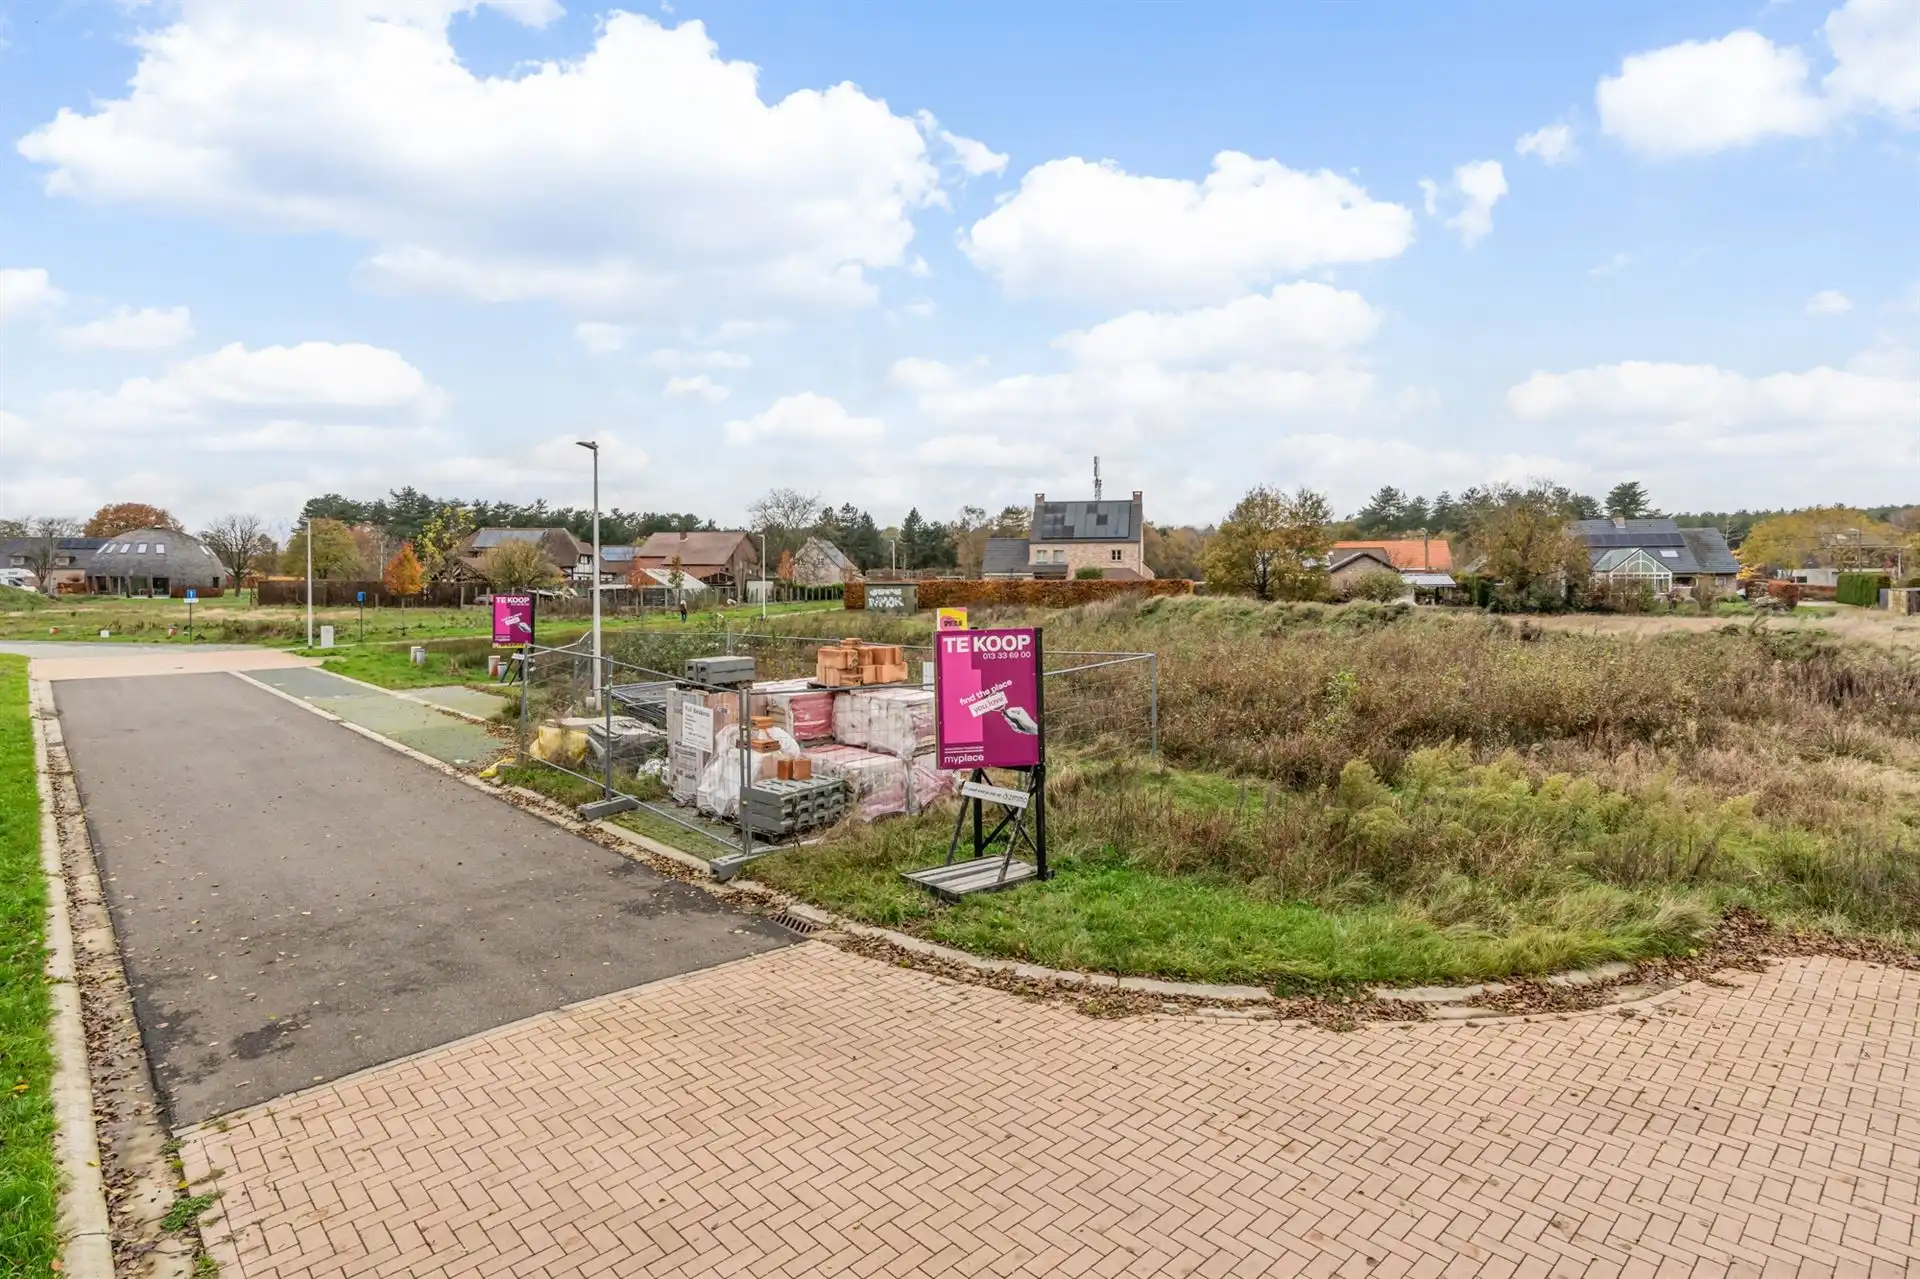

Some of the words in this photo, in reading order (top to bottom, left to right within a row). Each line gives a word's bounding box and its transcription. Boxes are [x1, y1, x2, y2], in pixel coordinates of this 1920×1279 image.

[943, 637, 969, 653] TE
[973, 635, 1031, 652] KOOP
[960, 694, 976, 706] find
[976, 688, 990, 699] the
[990, 680, 1012, 693] place
[972, 704, 988, 714] you
[944, 754, 984, 764] myplace
